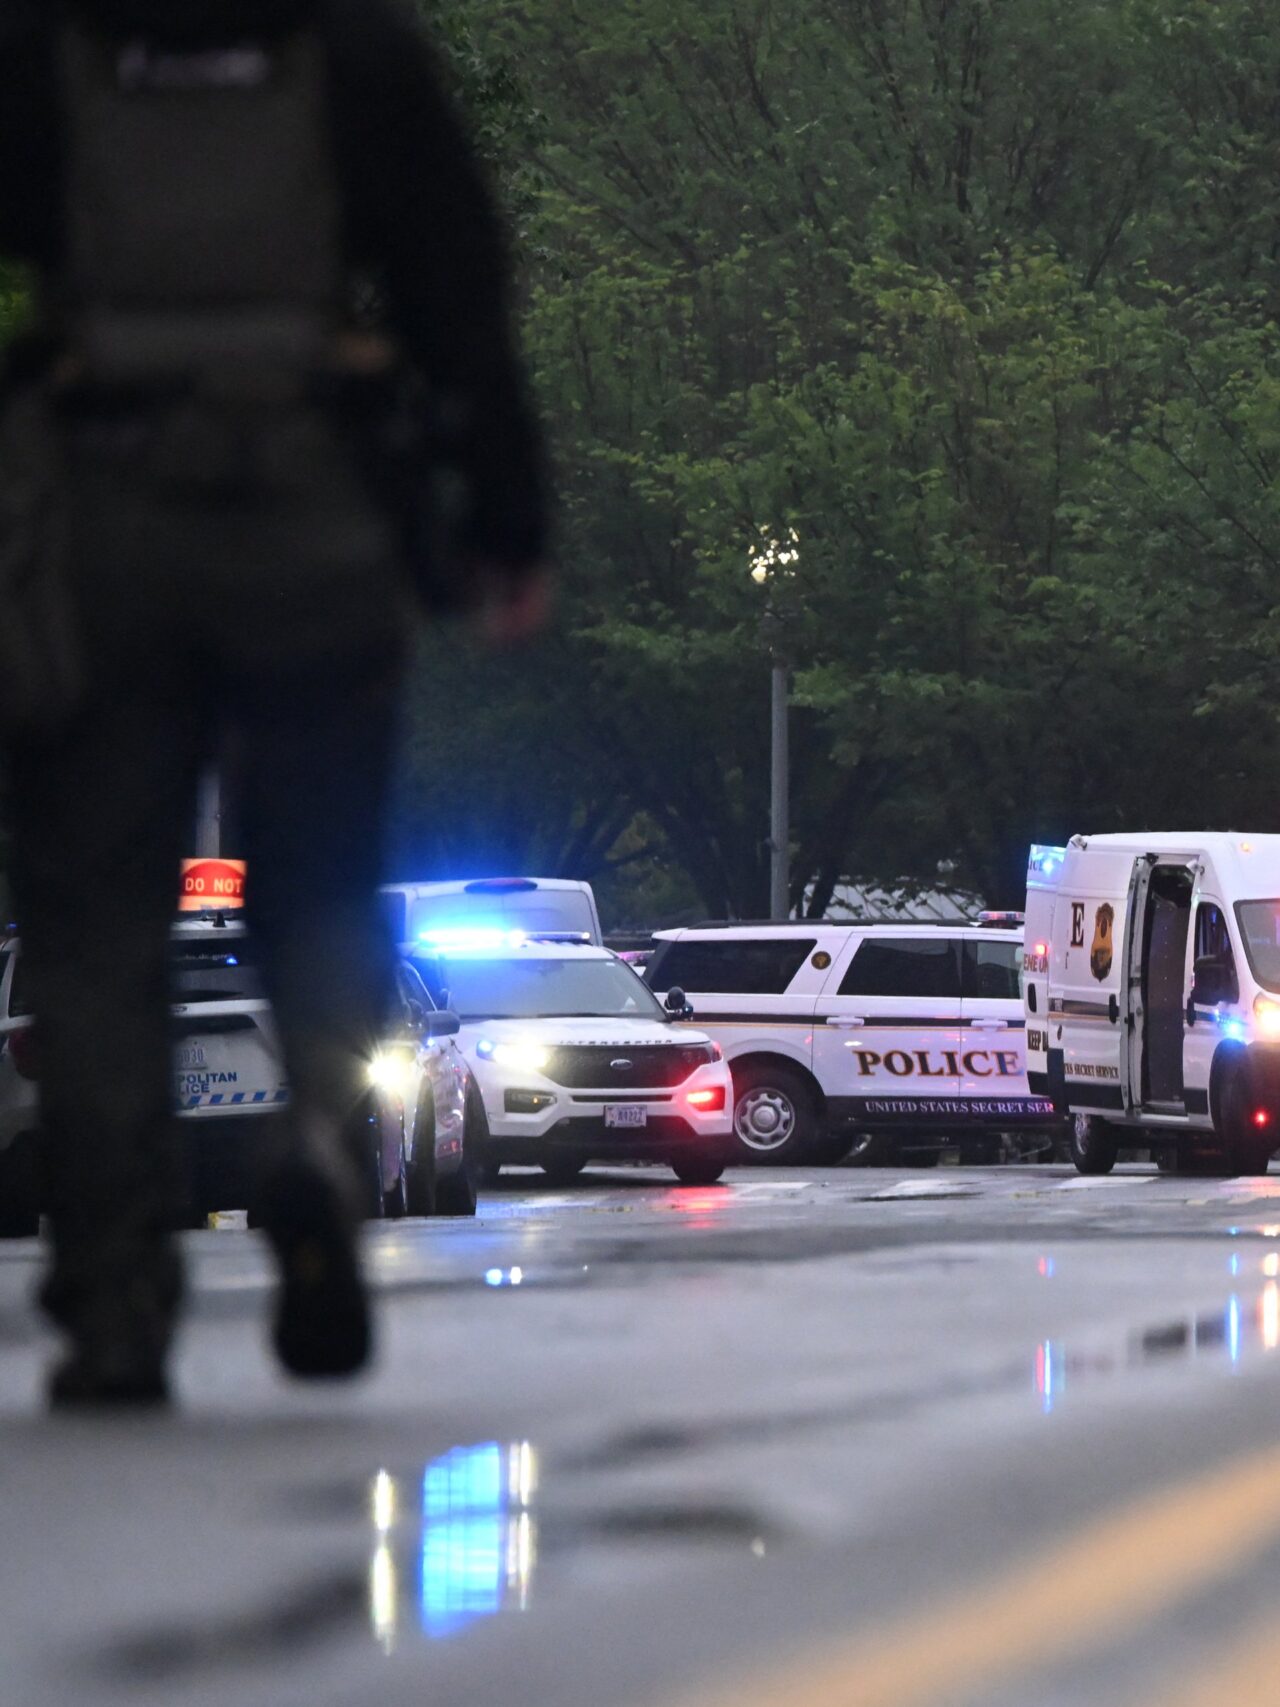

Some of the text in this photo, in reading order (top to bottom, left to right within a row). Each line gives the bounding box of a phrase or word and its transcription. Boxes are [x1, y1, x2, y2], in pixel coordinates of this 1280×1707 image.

[185, 878, 242, 893] DO NOT
[853, 1050, 1025, 1077] POLICE
[865, 1101, 917, 1114] UNITED
[919, 1101, 969, 1114] STATES
[971, 1102, 1024, 1114] SECRET
